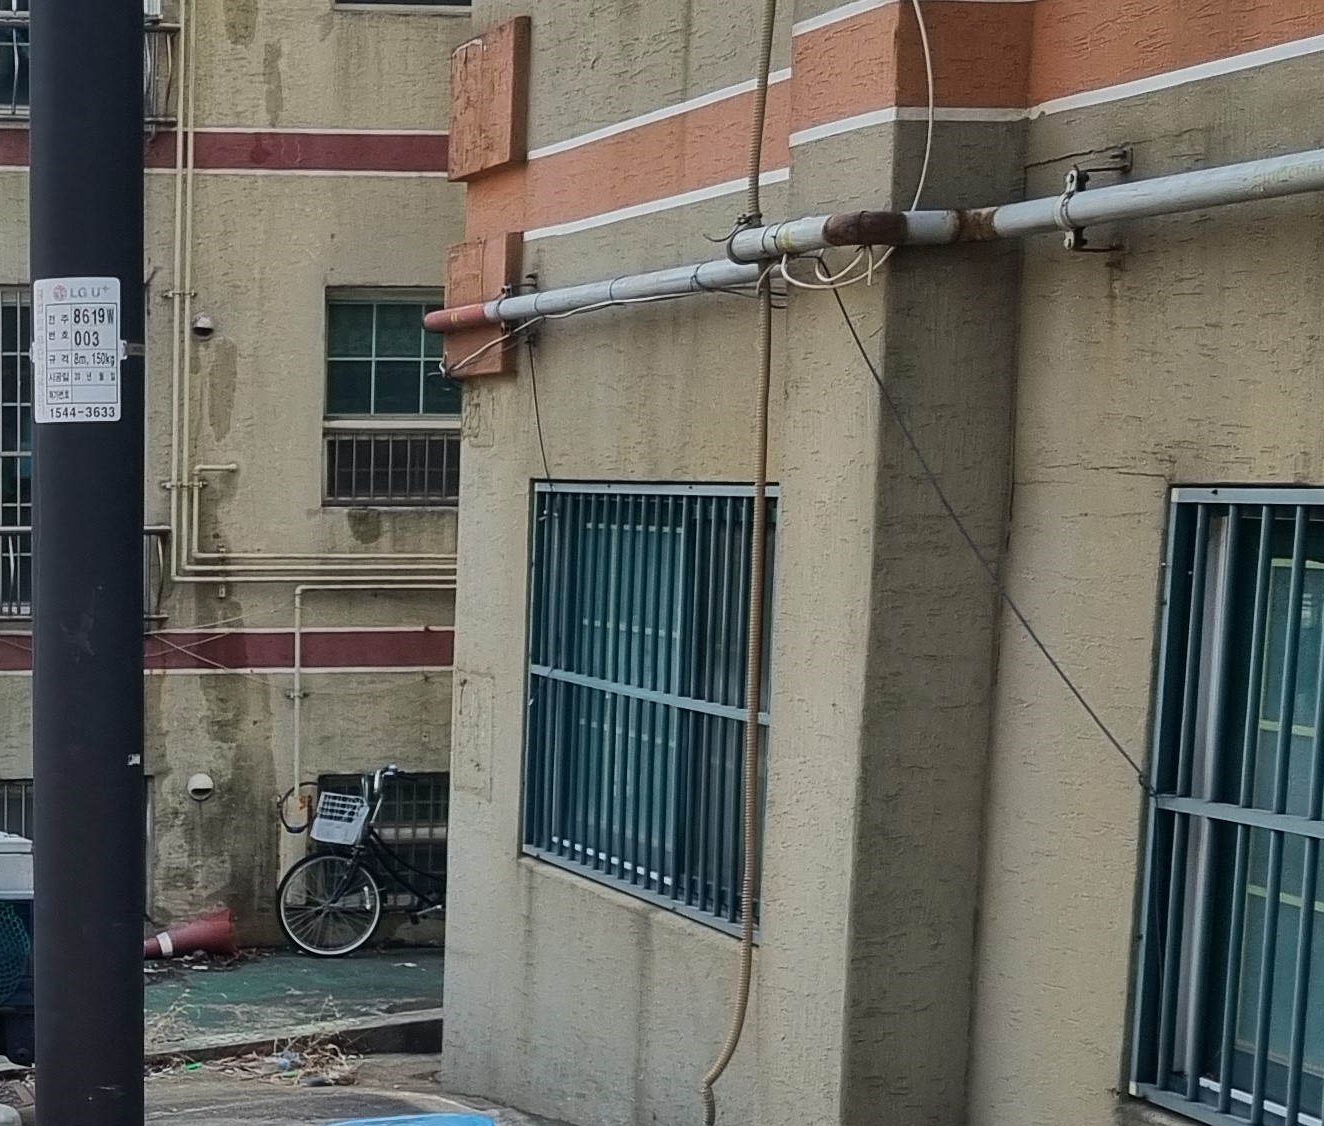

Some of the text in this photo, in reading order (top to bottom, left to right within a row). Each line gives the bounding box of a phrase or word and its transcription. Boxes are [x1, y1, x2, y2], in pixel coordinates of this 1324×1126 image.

[70, 287, 87, 298] LG
[73, 307, 114, 325] 8619W
[74, 331, 100, 347] 003
[92, 352, 115, 366] 150kg
[50, 406, 115, 418] 1544-3633
